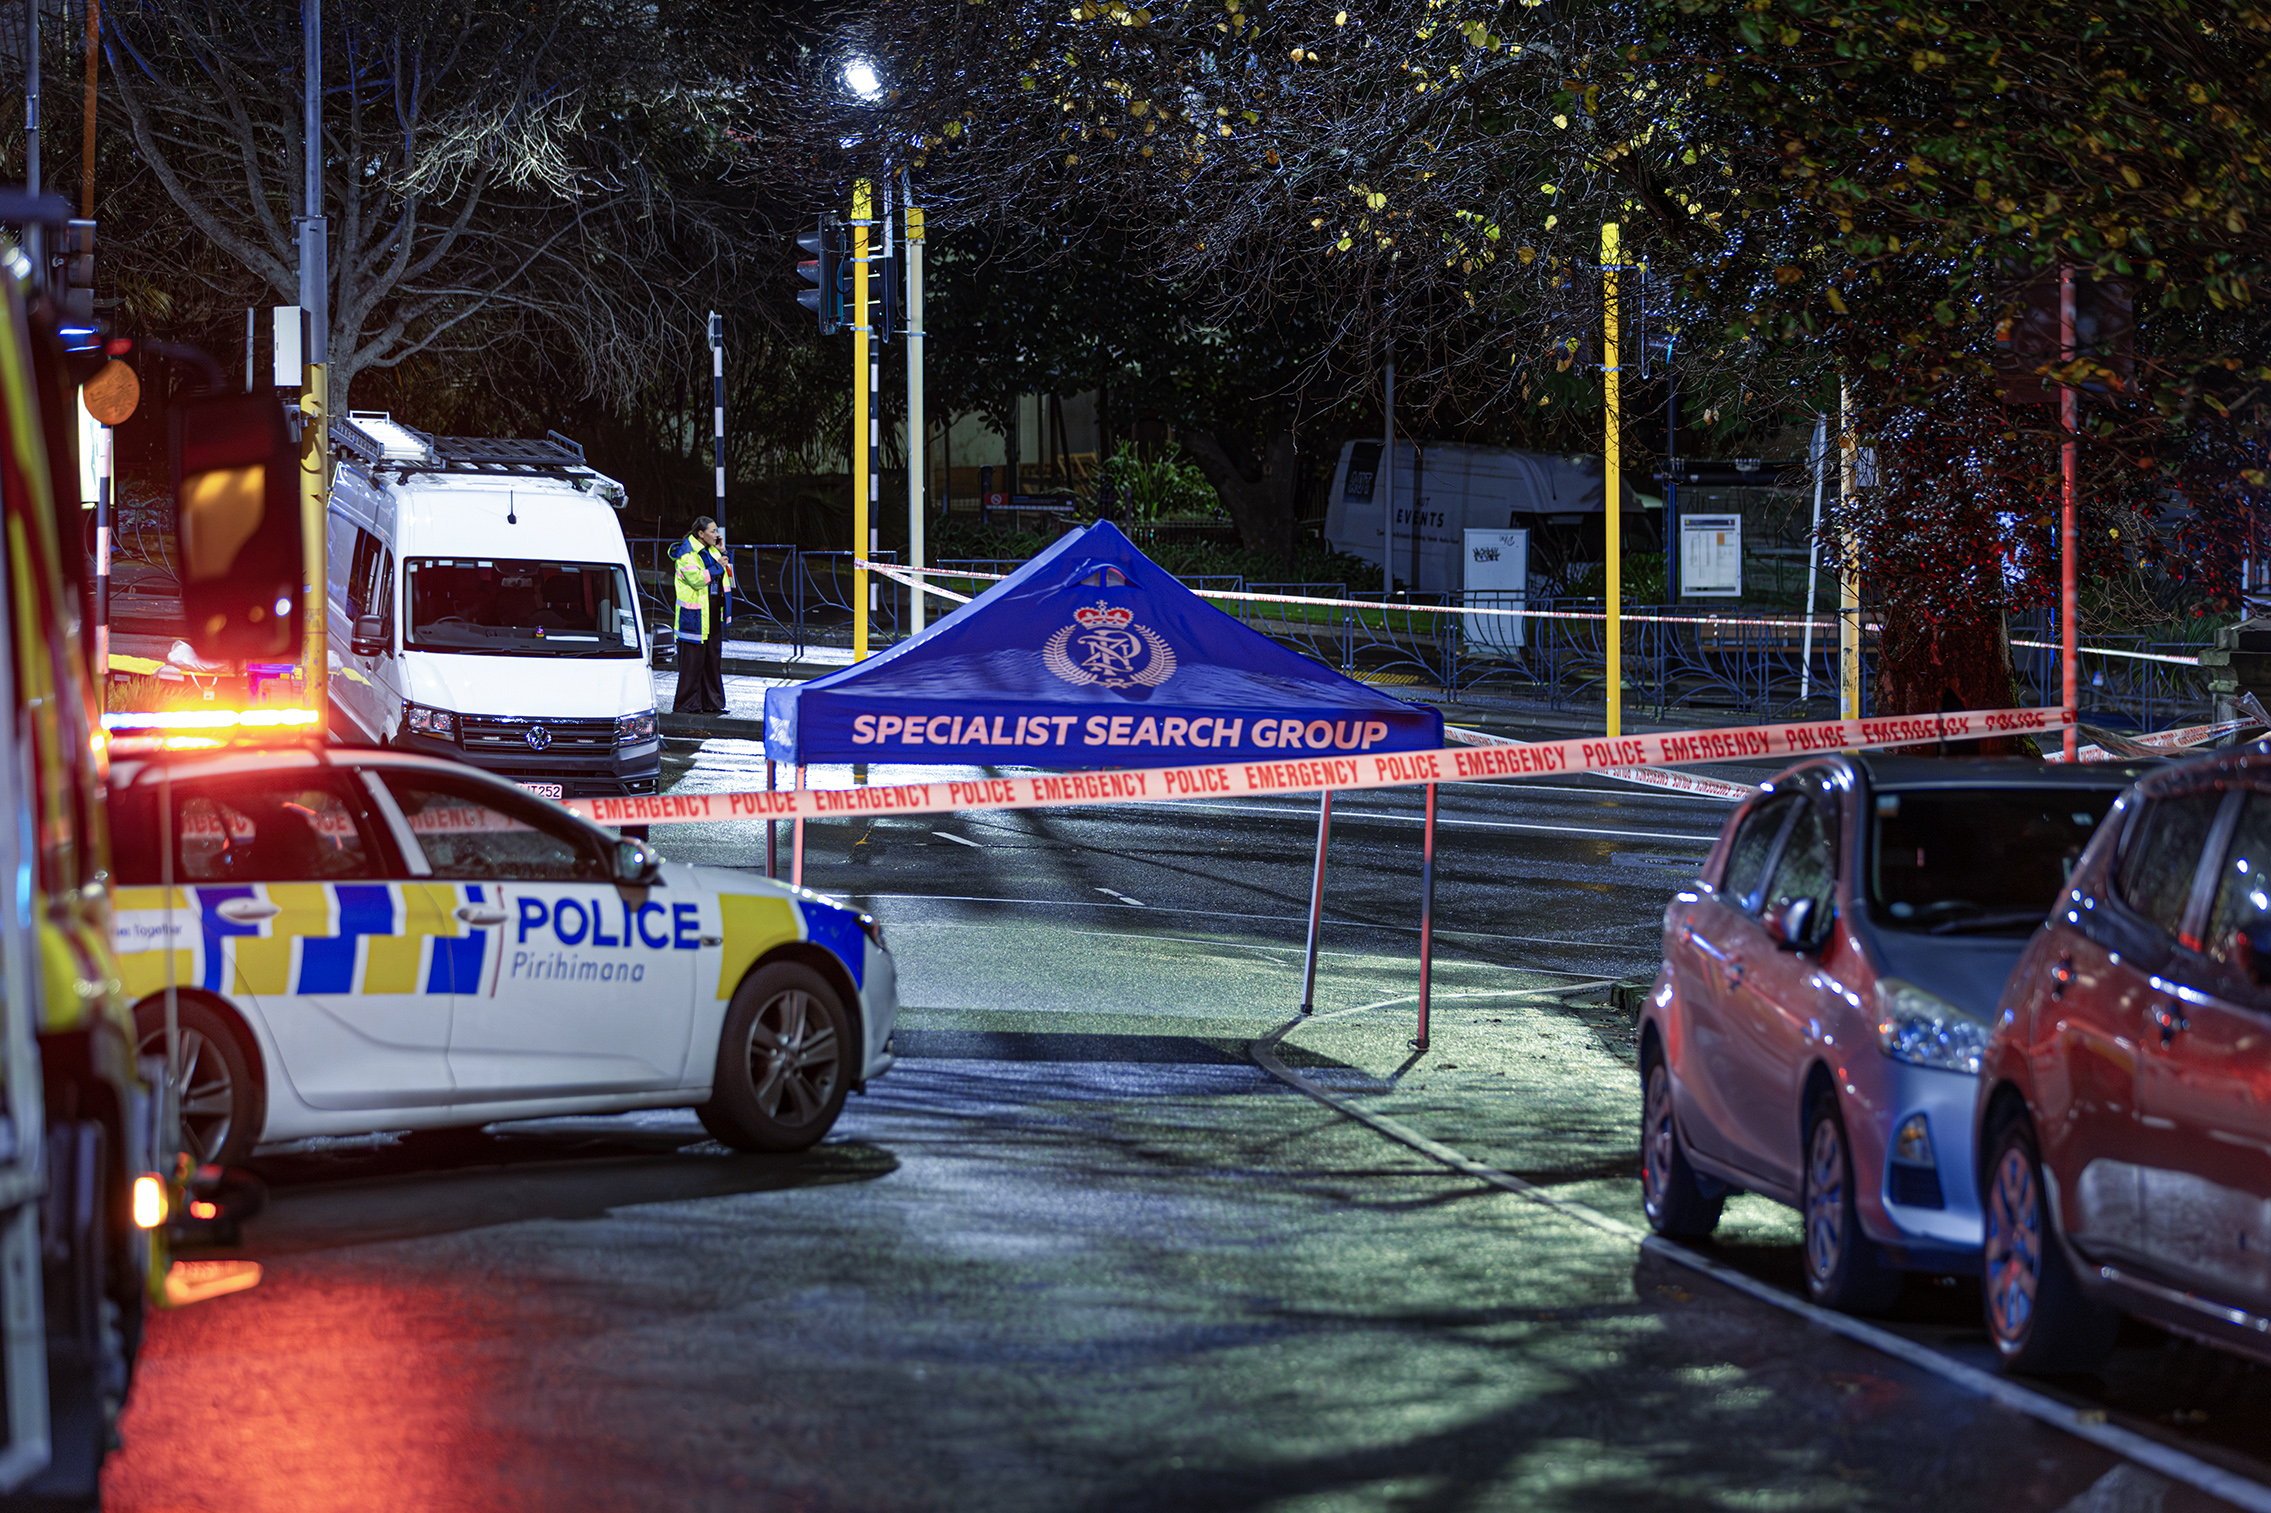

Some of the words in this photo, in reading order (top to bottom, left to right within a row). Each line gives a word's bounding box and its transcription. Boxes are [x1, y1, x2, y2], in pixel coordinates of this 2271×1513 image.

[1397, 509, 1445, 528] EVENTS
[852, 715, 1078, 746] SPECIALIST
[1084, 715, 1244, 748] SEARCH
[1251, 718, 1388, 750] GROUP
[591, 794, 711, 820] EMERGENCY
[730, 790, 798, 815] POLICE
[813, 785, 931, 811] EMERGENCY
[949, 779, 1016, 805] POLICE
[1031, 772, 1147, 801] EMERGENCY
[1164, 767, 1230, 794] POLICE
[1245, 759, 1358, 790] EMERGENCY
[1375, 754, 1441, 782] POLICE
[1454, 745, 1566, 777] EMERGENCY
[1582, 740, 1647, 768] POLICE
[1660, 731, 1770, 762] EMERGENCY
[1785, 725, 1849, 751] POLICE
[1862, 717, 1969, 744] EMERGENCY
[1985, 712, 2045, 731] POLICE
[515, 785, 561, 798] T252
[517, 897, 700, 950] POLICE
[511, 951, 645, 983] Pirihimana
